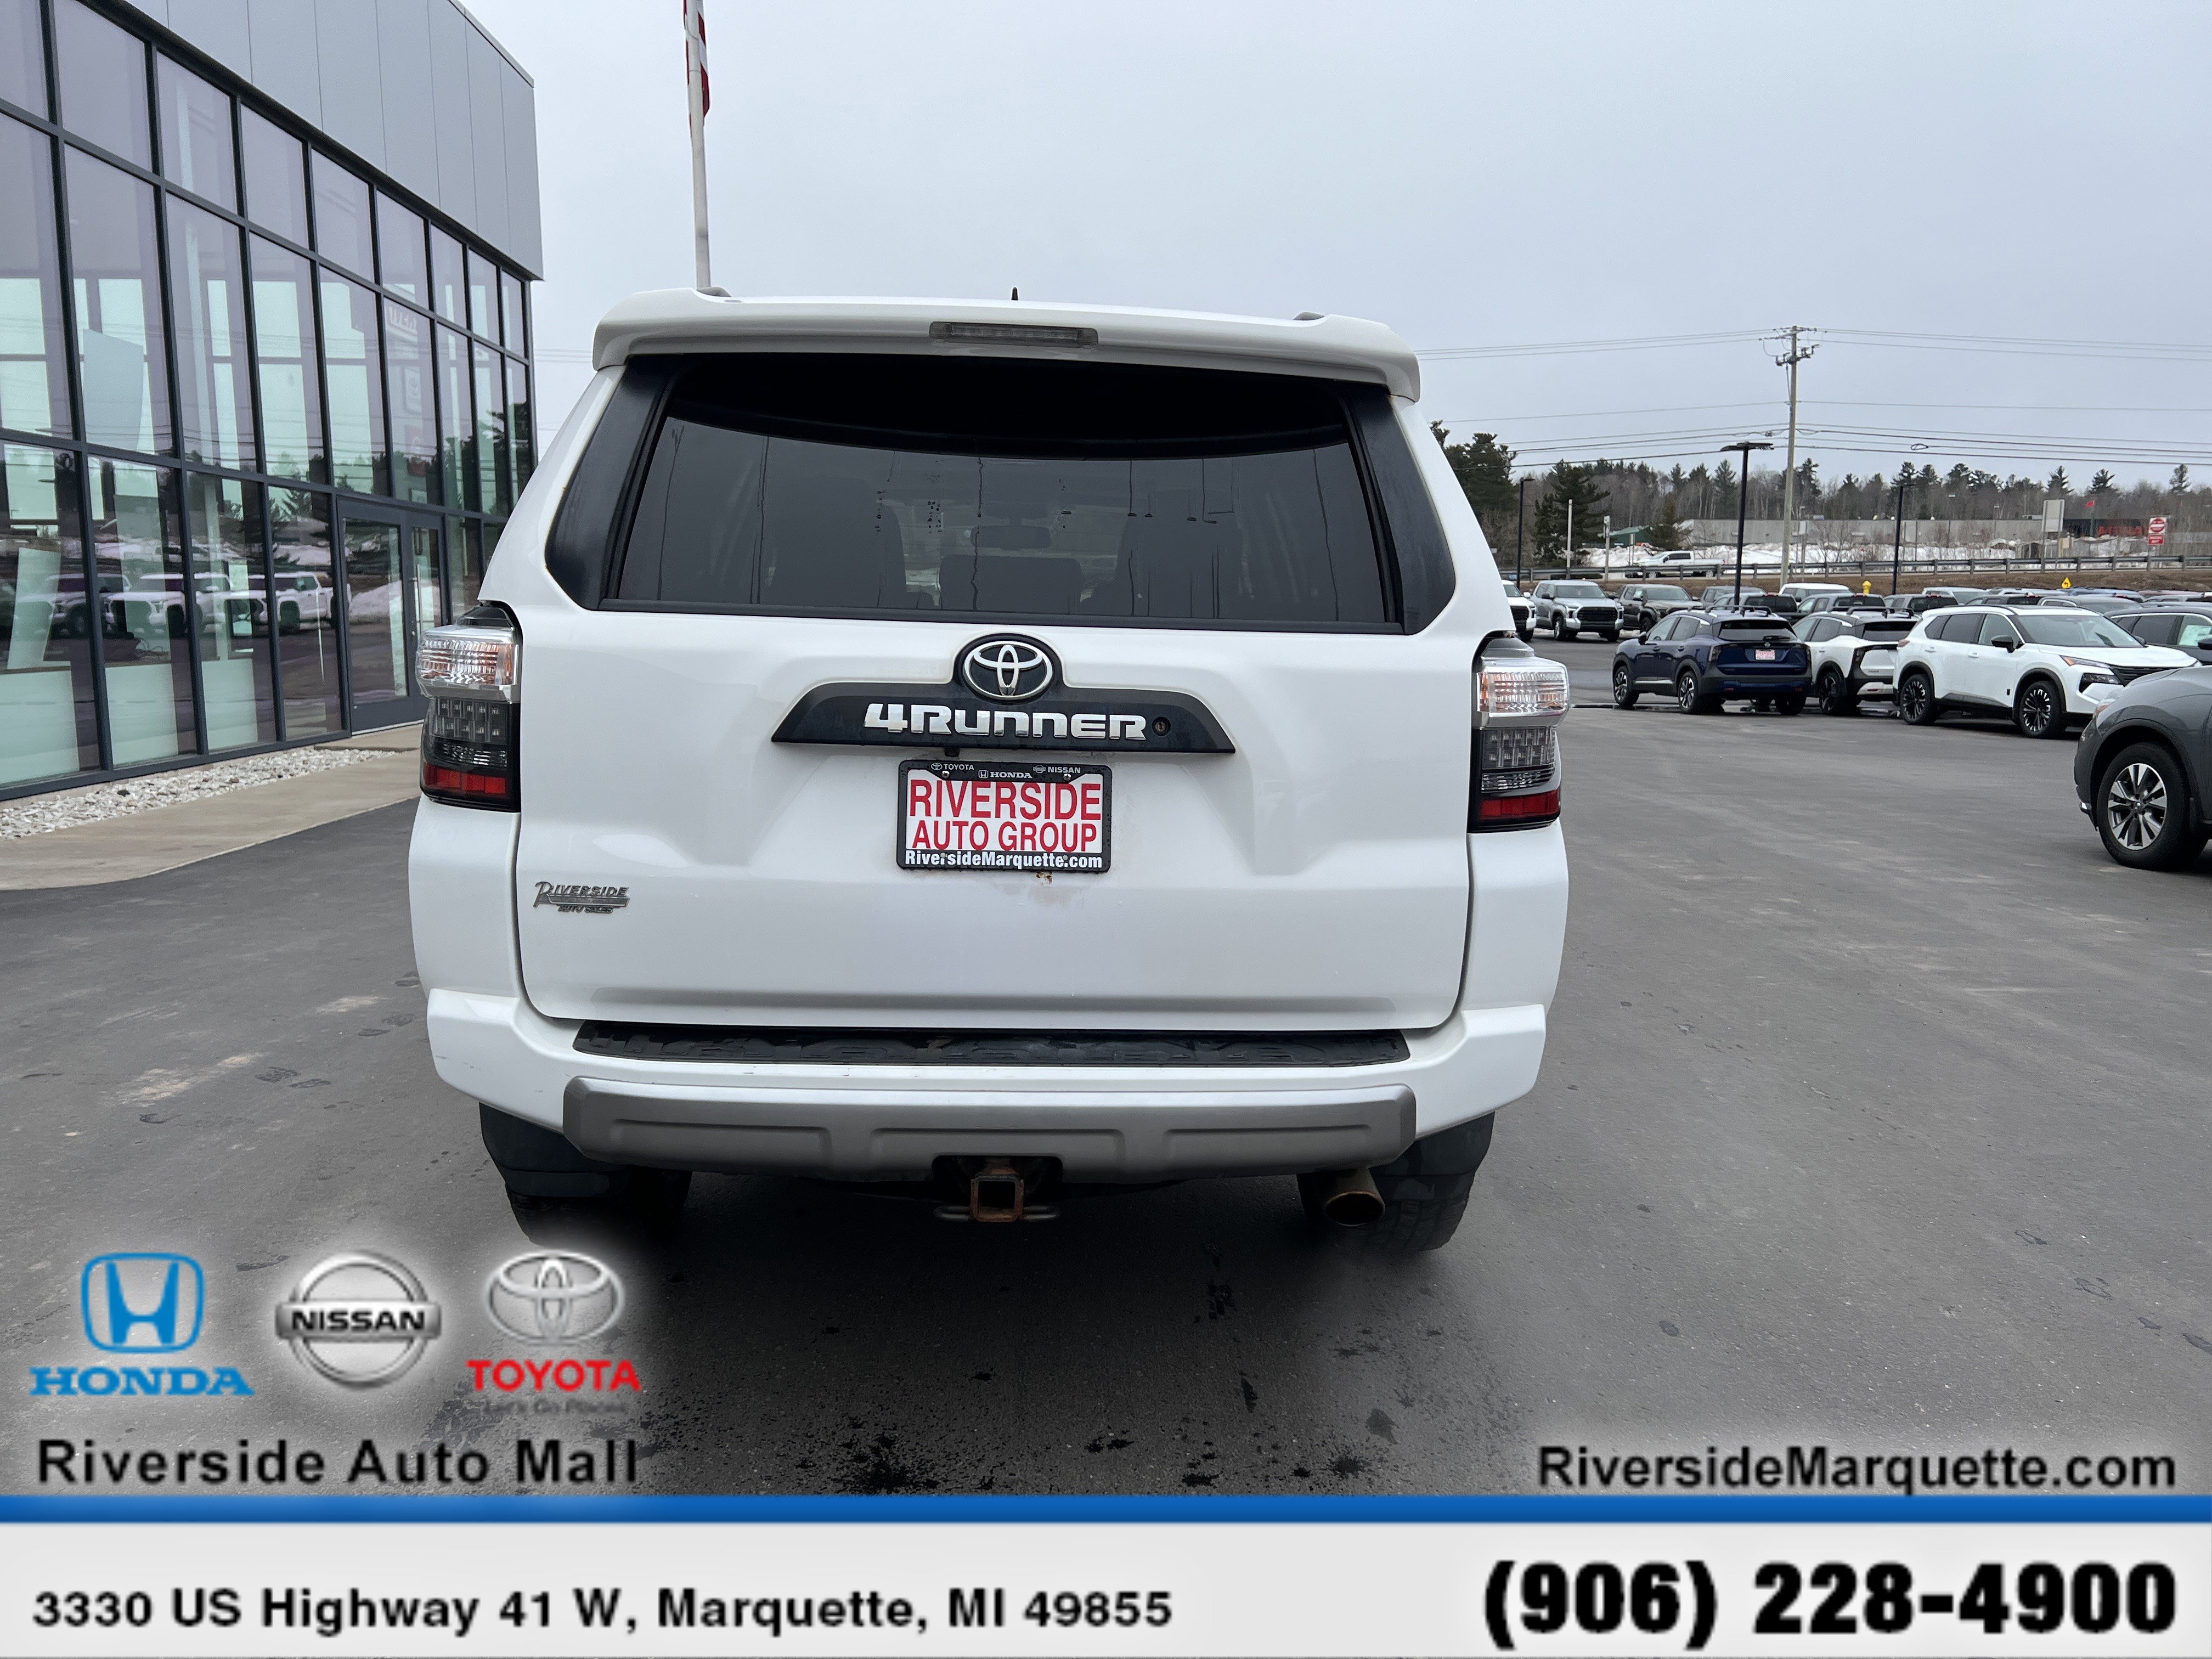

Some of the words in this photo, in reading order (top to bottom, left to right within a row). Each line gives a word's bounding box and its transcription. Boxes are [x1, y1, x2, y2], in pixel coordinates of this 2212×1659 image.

[1047, 766, 1081, 774] NISSAN
[909, 778, 1102, 821] RIVERSIDE
[912, 820, 989, 852] AUTO
[998, 821, 1097, 853] GROUP
[905, 850, 1103, 869] RiversideMarquette.com
